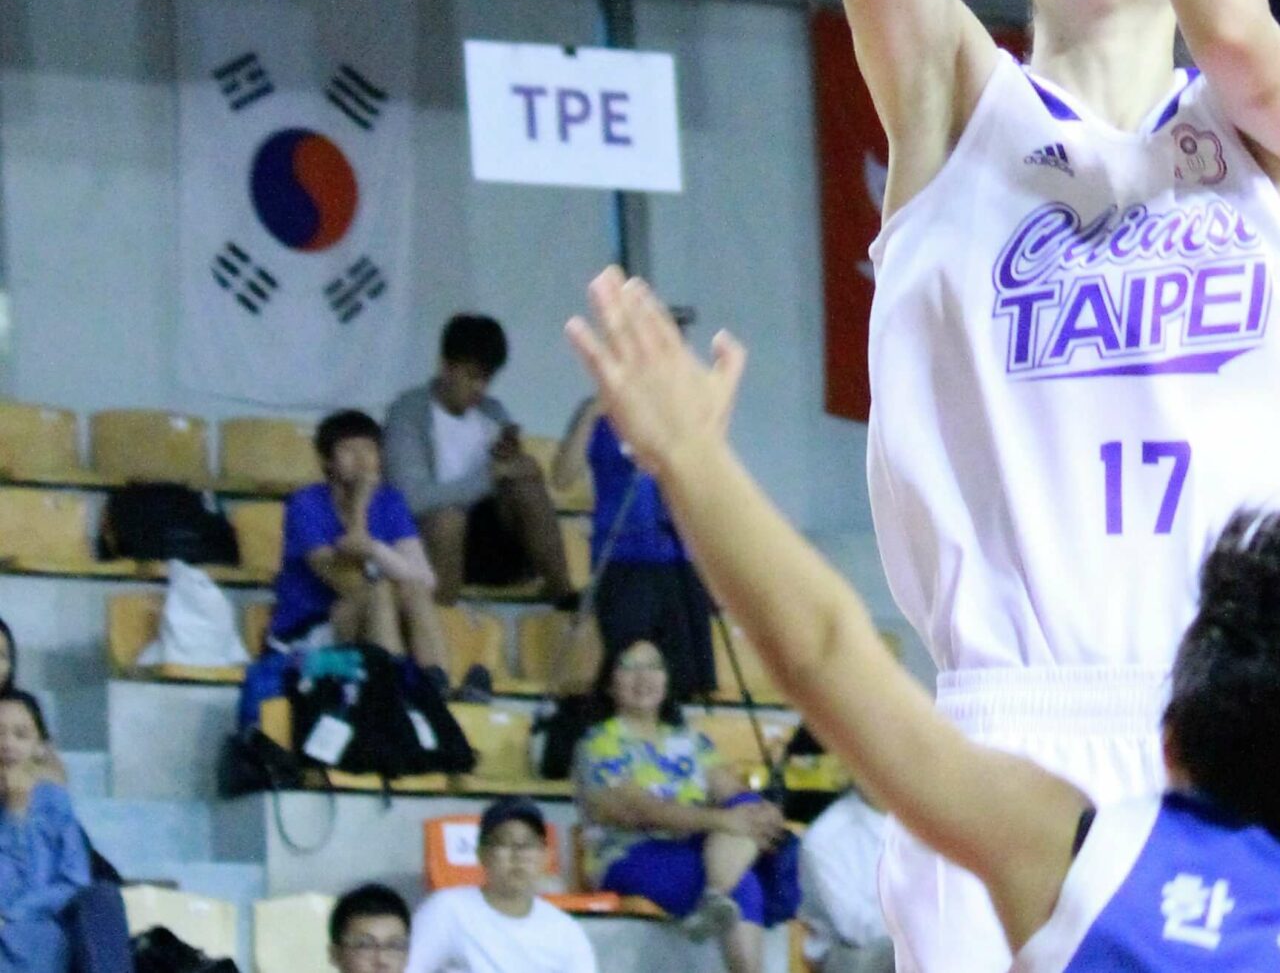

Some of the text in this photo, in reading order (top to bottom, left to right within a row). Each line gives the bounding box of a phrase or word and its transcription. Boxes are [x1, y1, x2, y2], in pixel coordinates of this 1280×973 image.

[511, 84, 632, 147] TPE
[995, 257, 1270, 371] TAIPEI
[1100, 441, 1191, 535] 17
